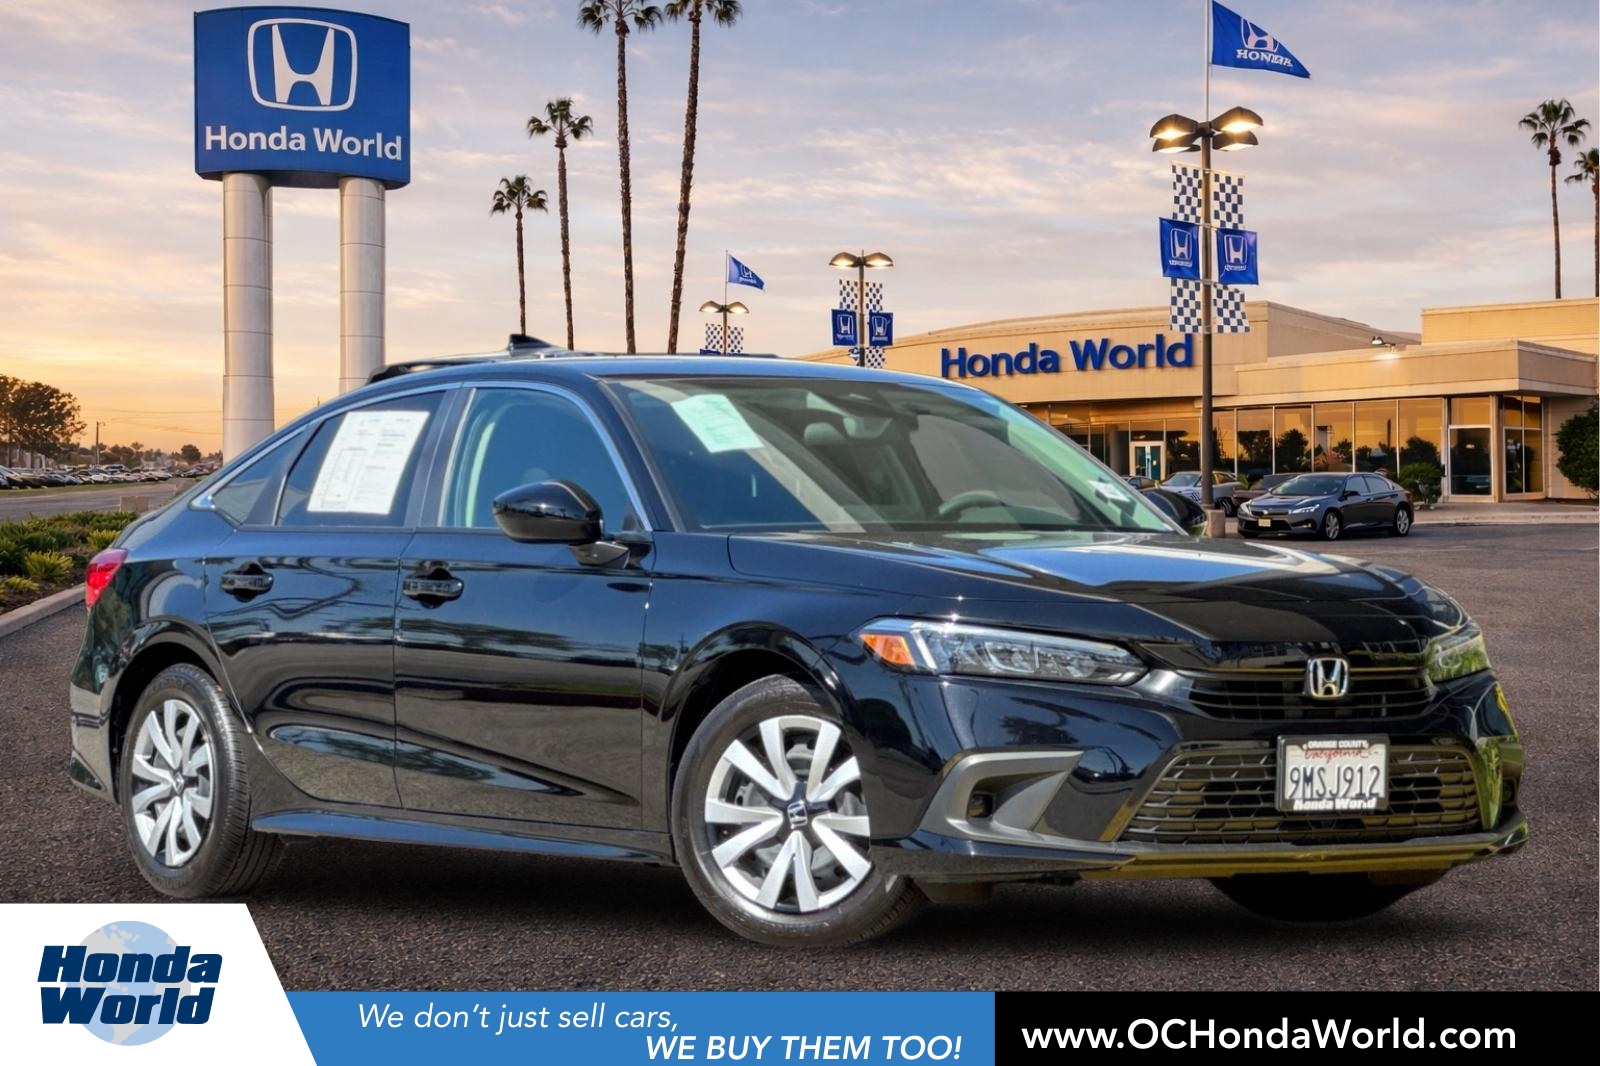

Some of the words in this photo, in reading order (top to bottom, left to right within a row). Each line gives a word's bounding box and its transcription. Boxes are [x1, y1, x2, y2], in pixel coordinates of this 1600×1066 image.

[205, 125, 306, 151] Honda
[313, 127, 402, 161] World
[941, 342, 1061, 379] Honda
[1069, 333, 1195, 371] World
[1289, 765, 1381, 799] 9MSJ912
